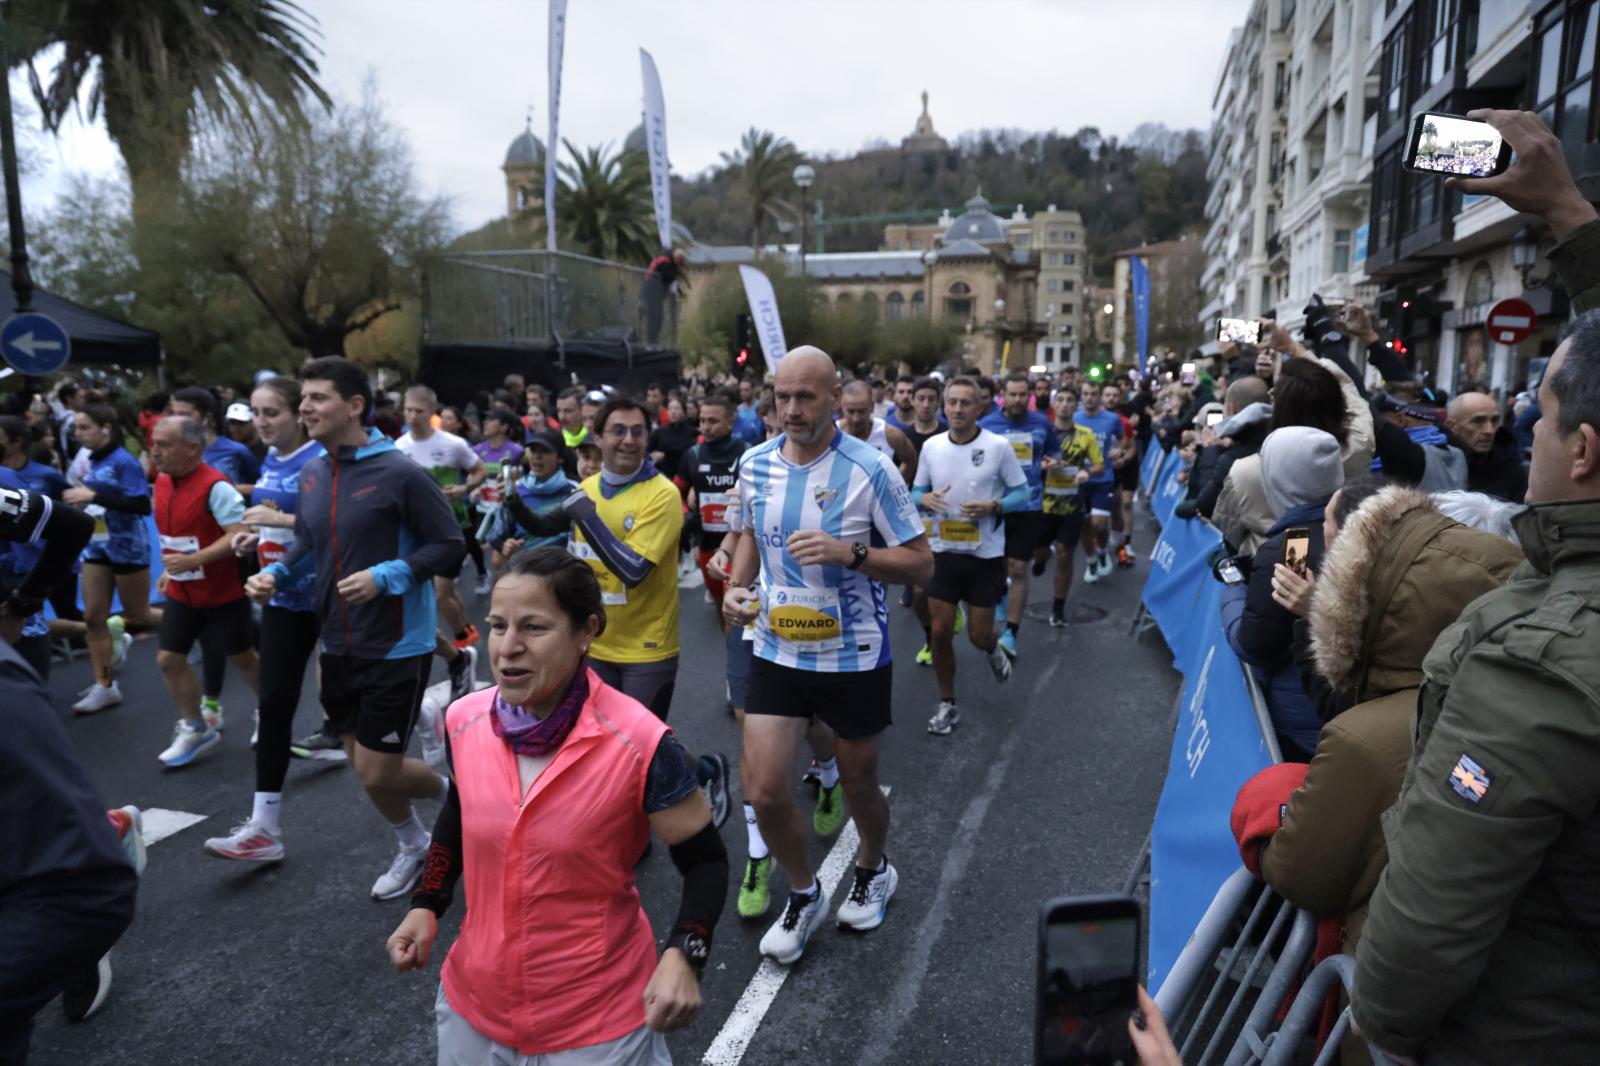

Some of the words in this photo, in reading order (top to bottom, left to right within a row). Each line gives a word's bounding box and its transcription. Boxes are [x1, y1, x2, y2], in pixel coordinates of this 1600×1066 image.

[706, 475, 735, 486] YURI
[791, 594, 826, 603] ZURICH
[778, 618, 835, 629] EDWARD
